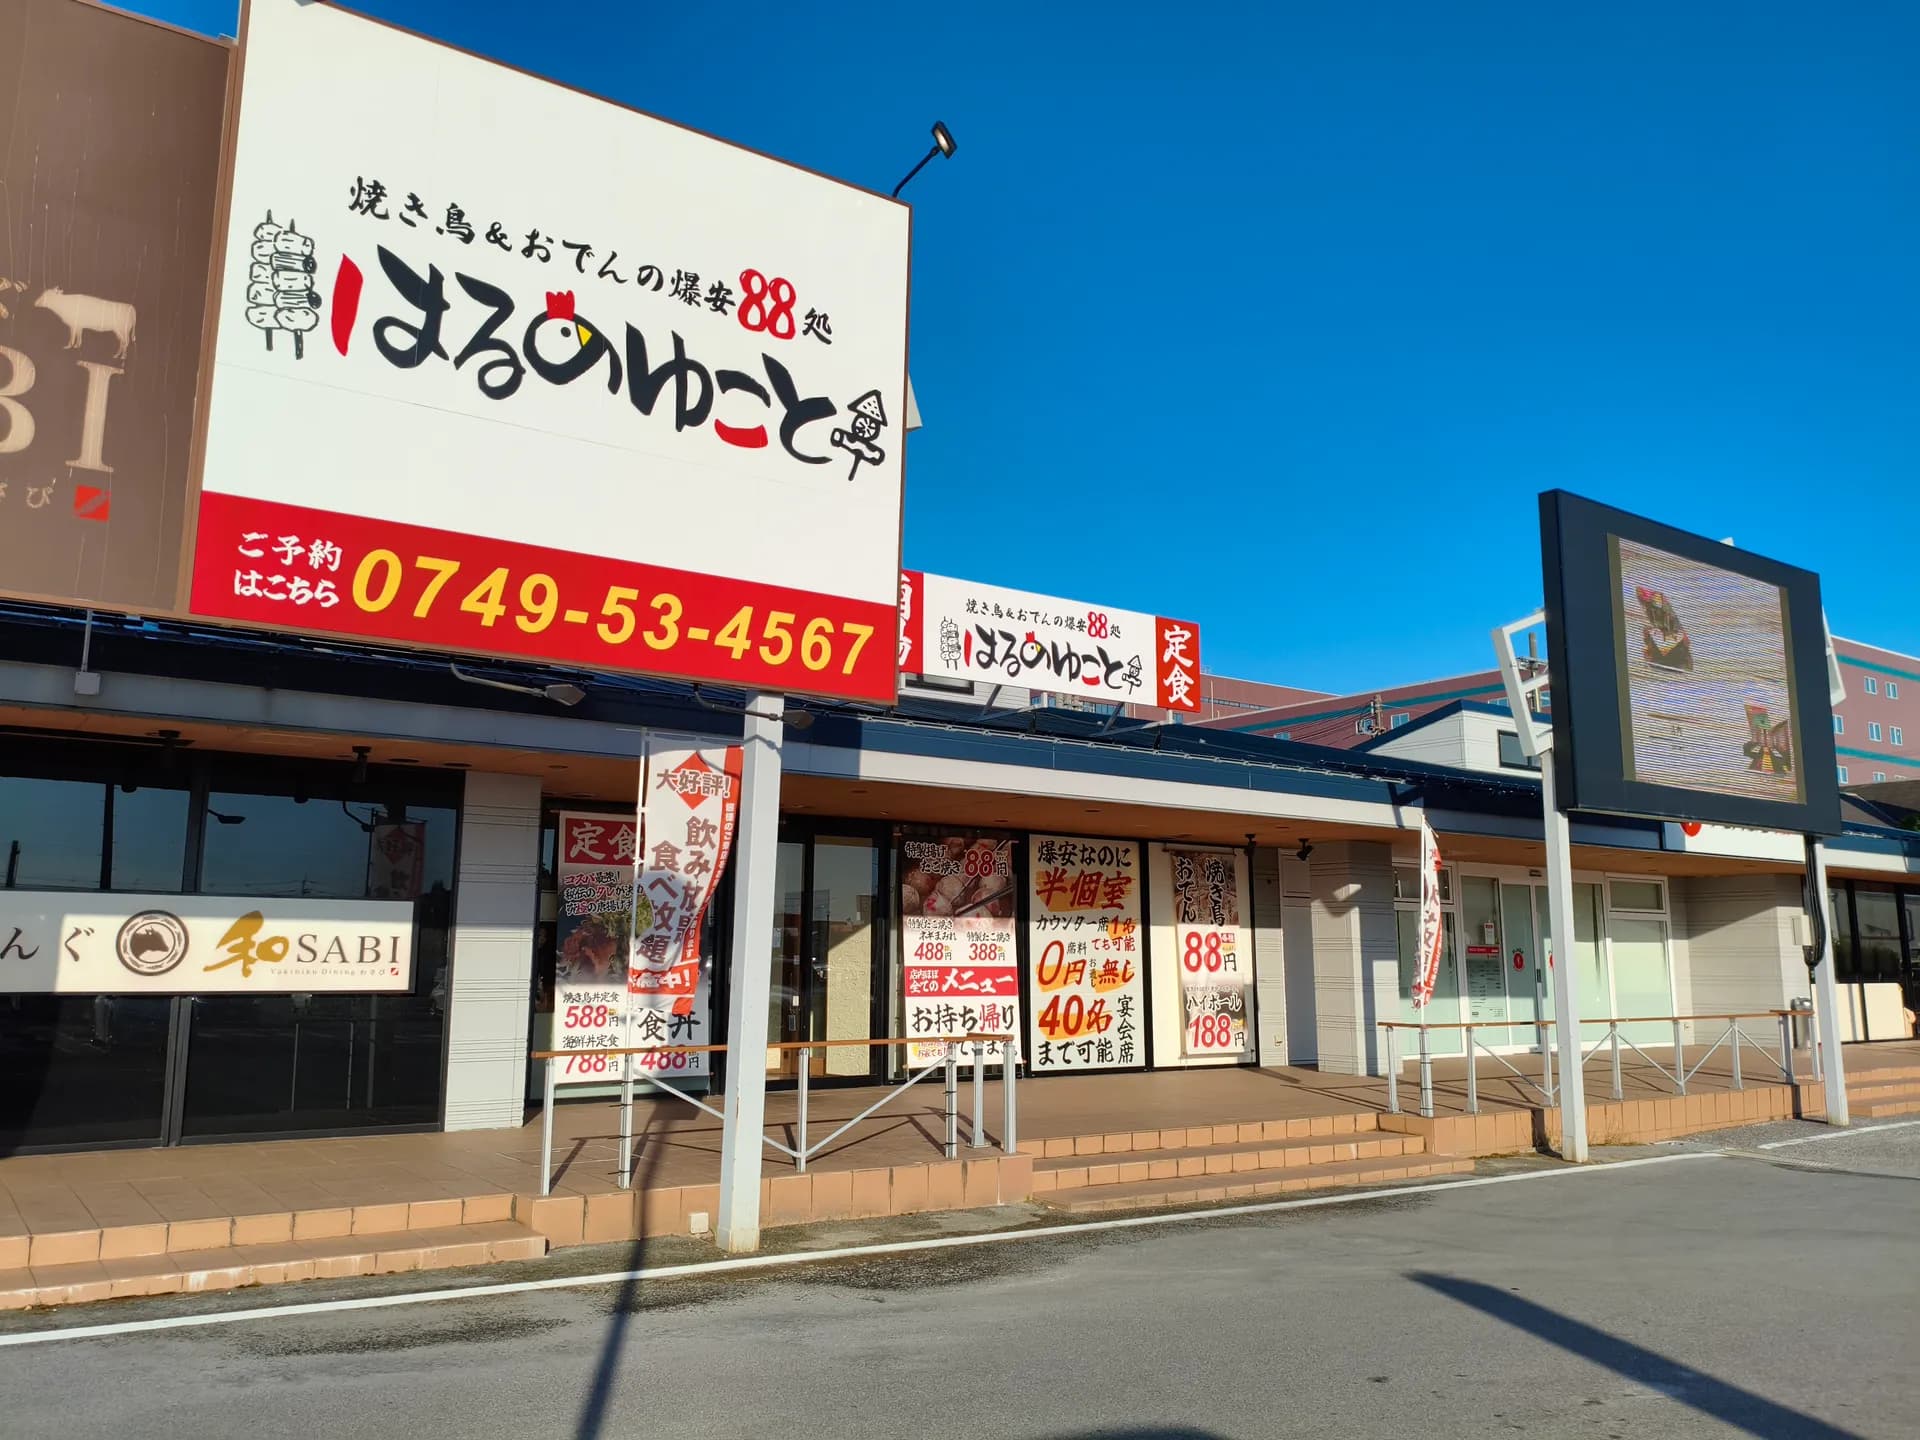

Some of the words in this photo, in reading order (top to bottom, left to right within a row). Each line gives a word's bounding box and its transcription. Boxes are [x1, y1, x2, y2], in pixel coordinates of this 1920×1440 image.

[331, 243, 838, 465] はるのゆこと
[237, 530, 343, 571] ご予約
[233, 568, 341, 608] はこちら
[350, 547, 875, 677] 0749-53-4567
[963, 622, 1123, 690] はるのゆこと
[1162, 623, 1194, 708] 定食
[655, 768, 731, 798] 大好評!
[569, 822, 636, 861] 定食
[1038, 840, 1132, 867] 爆安なのに
[921, 859, 960, 875] たこ焼き
[1036, 866, 1133, 910] 半個室
[1176, 857, 1197, 924] おでん
[1206, 858, 1226, 927] 焼き鳥
[1036, 914, 1109, 932] カウンター席
[1111, 914, 1136, 935] 1名
[909, 980, 939, 993] 全ての
[941, 967, 1014, 994] メニュー
[1098, 957, 1135, 984] 無し
[563, 991, 619, 1004] 焼き鳥丼定食
[1038, 994, 1113, 1034] 40名
[1187, 993, 1241, 1011] ハイボール
[911, 1002, 1015, 1033] お持ち帰り
[1116, 994, 1136, 1064] 宴会席
[563, 1034, 619, 1049] 海鮮丼定食
[1038, 1037, 1115, 1065] まで可能
